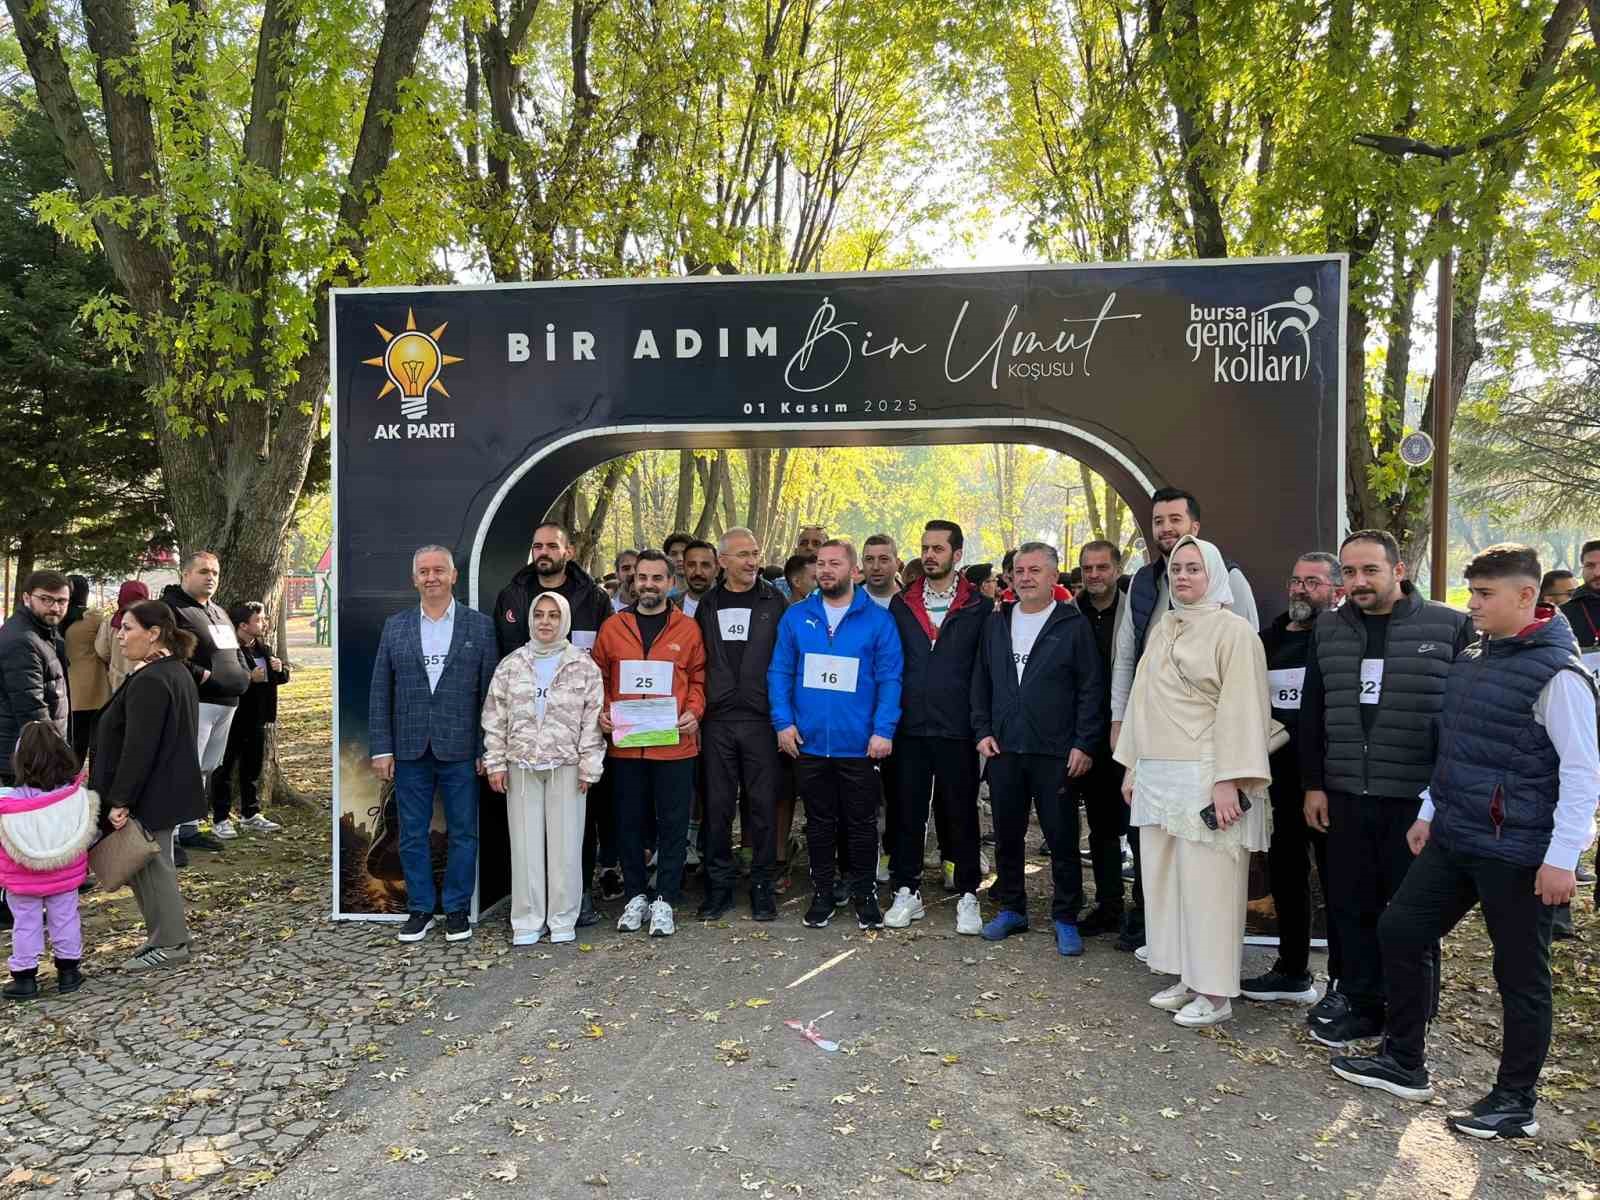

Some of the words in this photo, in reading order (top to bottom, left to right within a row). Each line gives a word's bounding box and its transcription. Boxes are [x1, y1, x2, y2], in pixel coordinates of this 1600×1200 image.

[1190, 303, 1247, 321] bursa
[508, 323, 596, 362] BİR
[633, 326, 777, 359] ADIM
[784, 296, 928, 392] Bin
[945, 291, 1144, 390] Umut
[1185, 311, 1278, 362] gençlik
[1008, 362, 1074, 381] KOŞUSU
[1214, 346, 1301, 382] kolları
[743, 402, 766, 414] 01
[781, 402, 848, 414] Kasım
[864, 399, 917, 412] 2025
[374, 424, 401, 440] AK
[727, 624, 745, 635] 49
[635, 677, 653, 688] 25
[821, 672, 838, 684] 16
